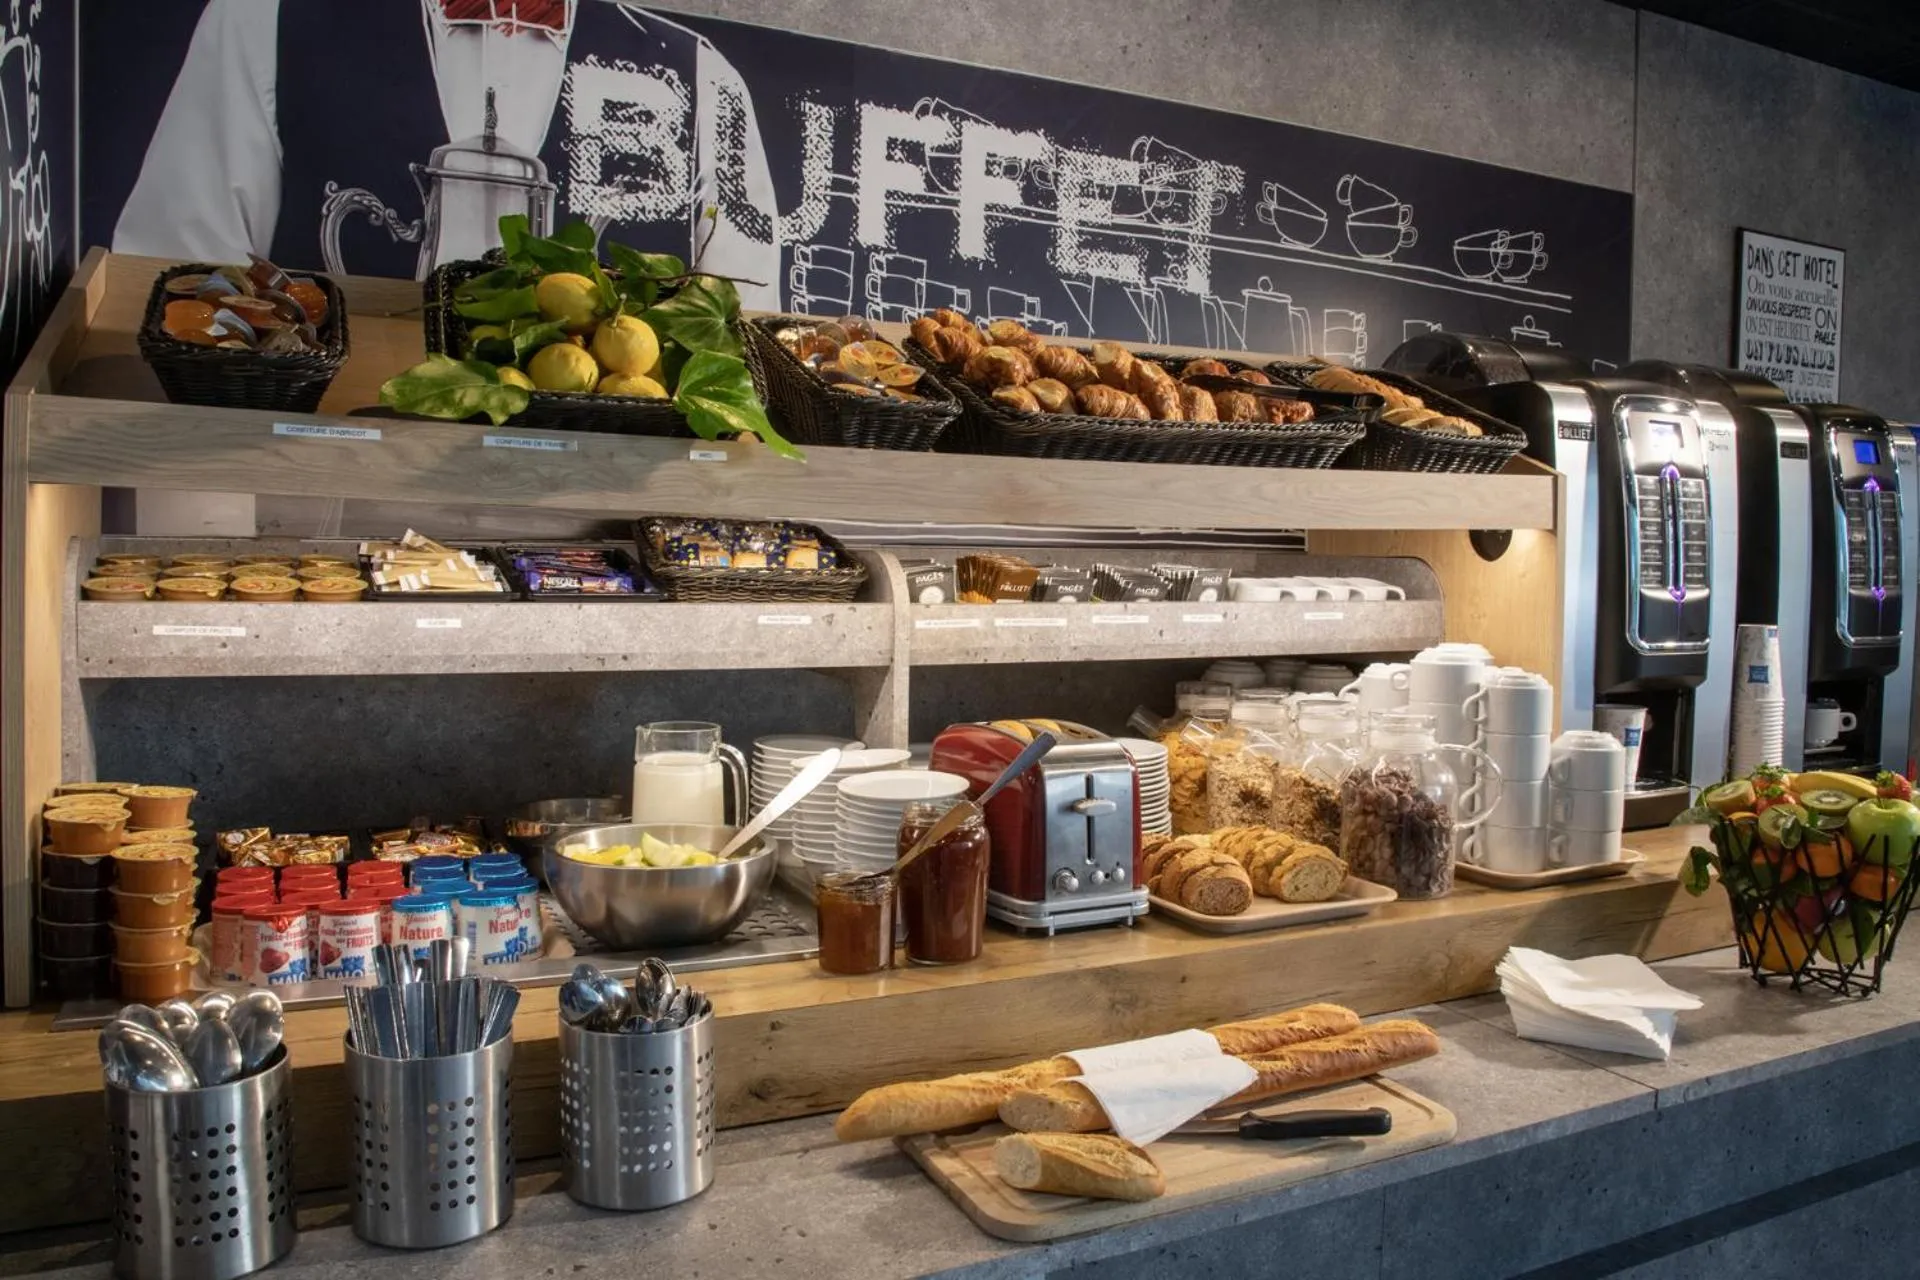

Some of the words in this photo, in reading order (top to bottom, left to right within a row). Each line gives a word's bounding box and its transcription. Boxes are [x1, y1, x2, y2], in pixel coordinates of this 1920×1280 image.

[562, 54, 1245, 297] BUFFET
[1747, 244, 1774, 278] DANS
[1778, 250, 1801, 278] CET
[1803, 255, 1838, 289] HOTEL
[1748, 275, 1765, 295] On
[1768, 284, 1793, 300] vous
[1814, 307, 1837, 330] ON
[399, 925, 444, 941] Nature
